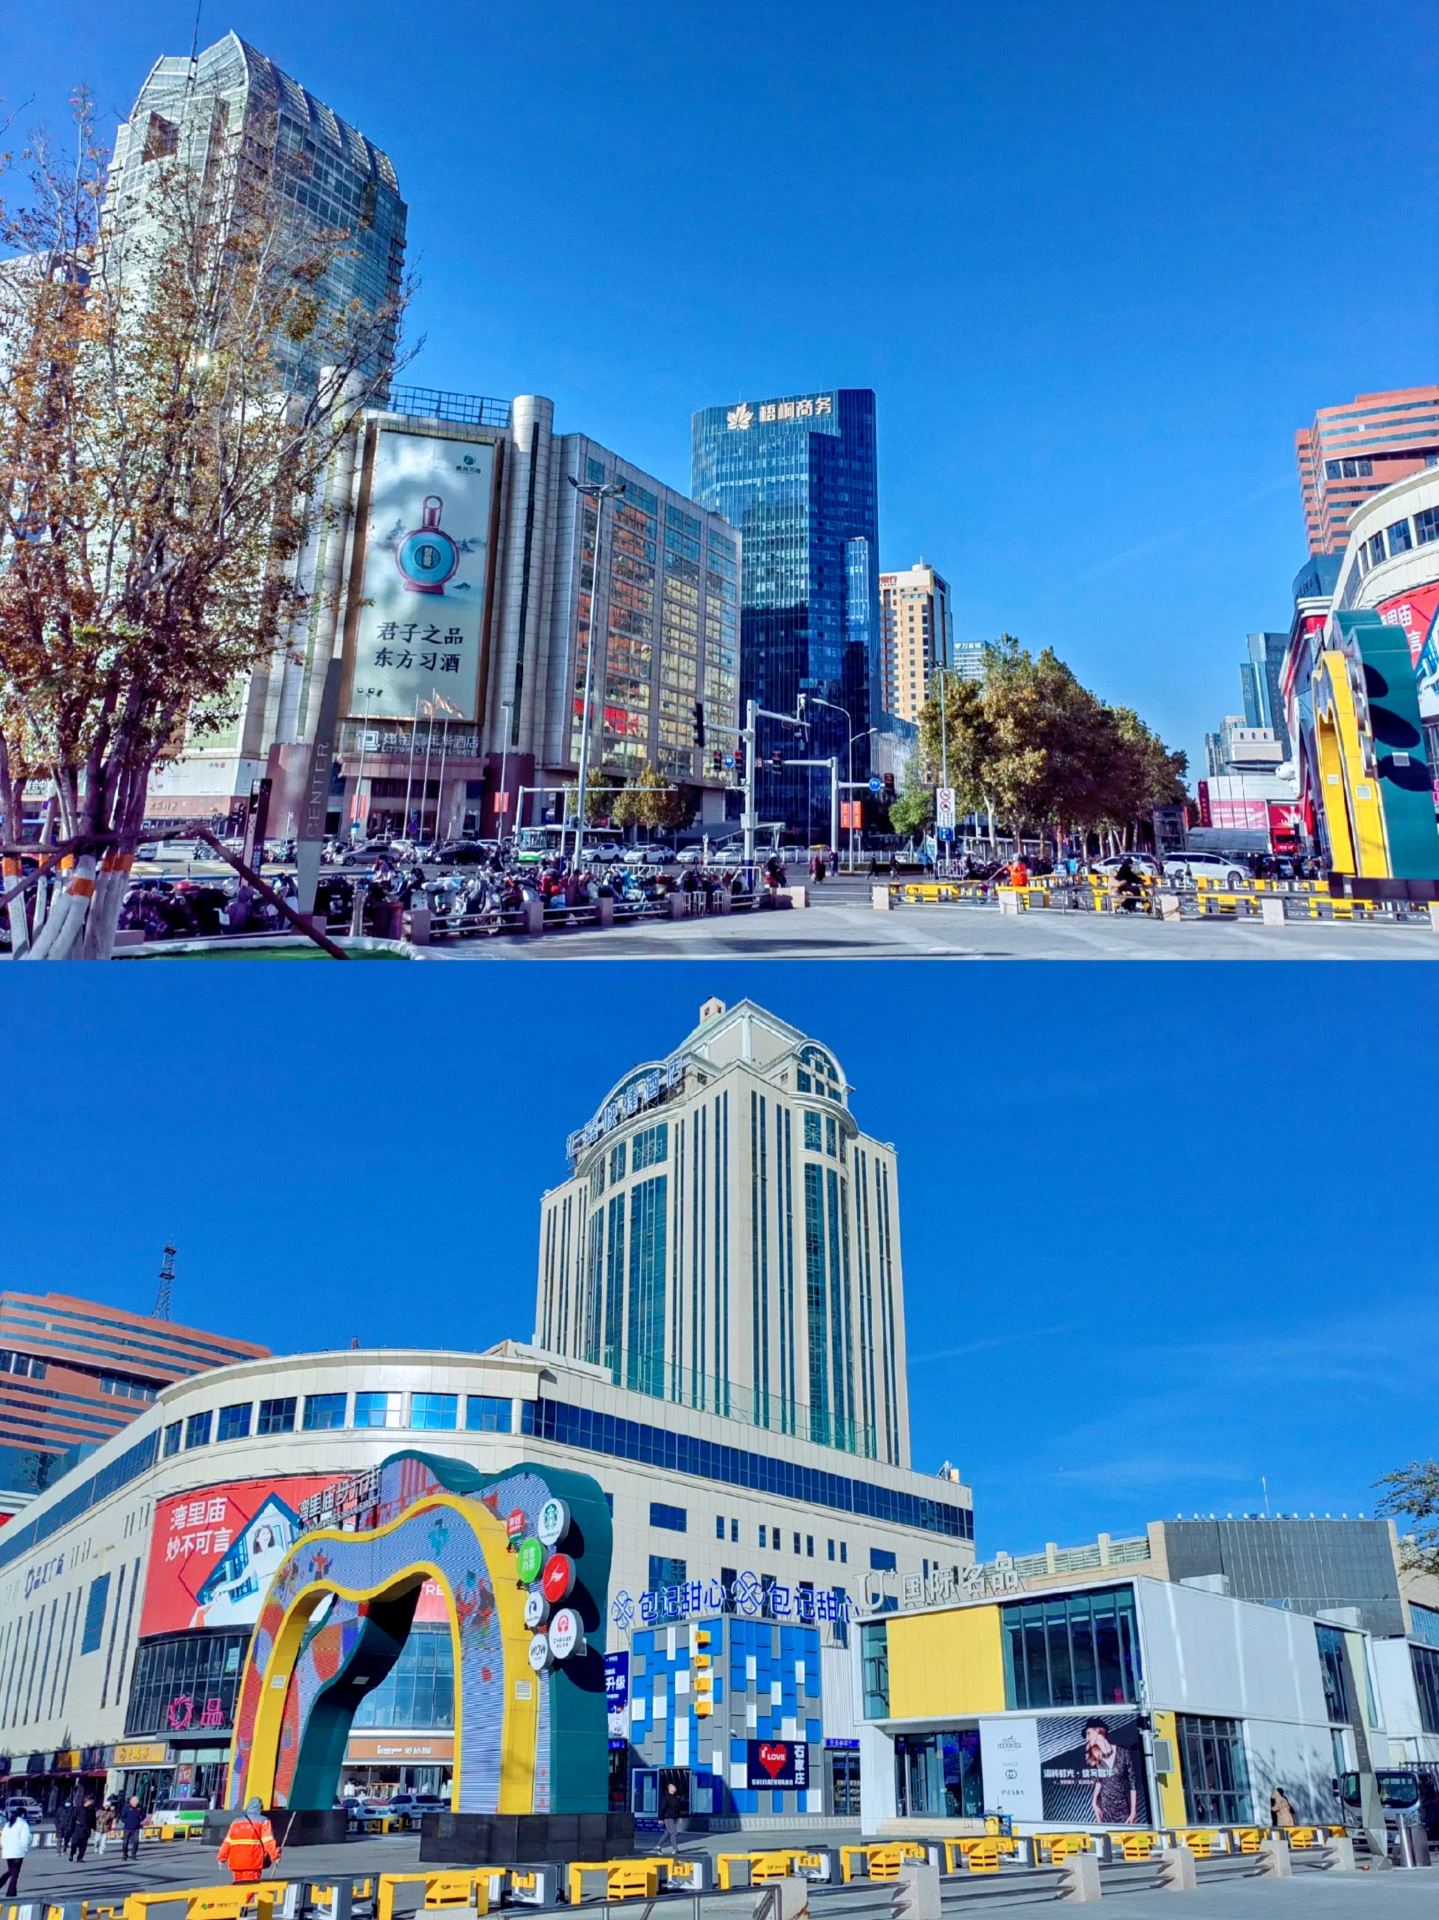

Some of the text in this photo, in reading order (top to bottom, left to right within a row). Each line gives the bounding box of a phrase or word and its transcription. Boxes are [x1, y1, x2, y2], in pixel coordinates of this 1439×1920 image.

[376, 621, 464, 646] 君子之品
[374, 647, 461, 673] 东方习酒
[170, 1497, 228, 1531] 湾里庙
[165, 1528, 233, 1563] 妙不可言
[638, 1578, 726, 1622] 包记甜心
[767, 1581, 860, 1624] 包记甜心
[767, 1753, 786, 1761] LOVE
[794, 1744, 806, 1785] 石家庄
